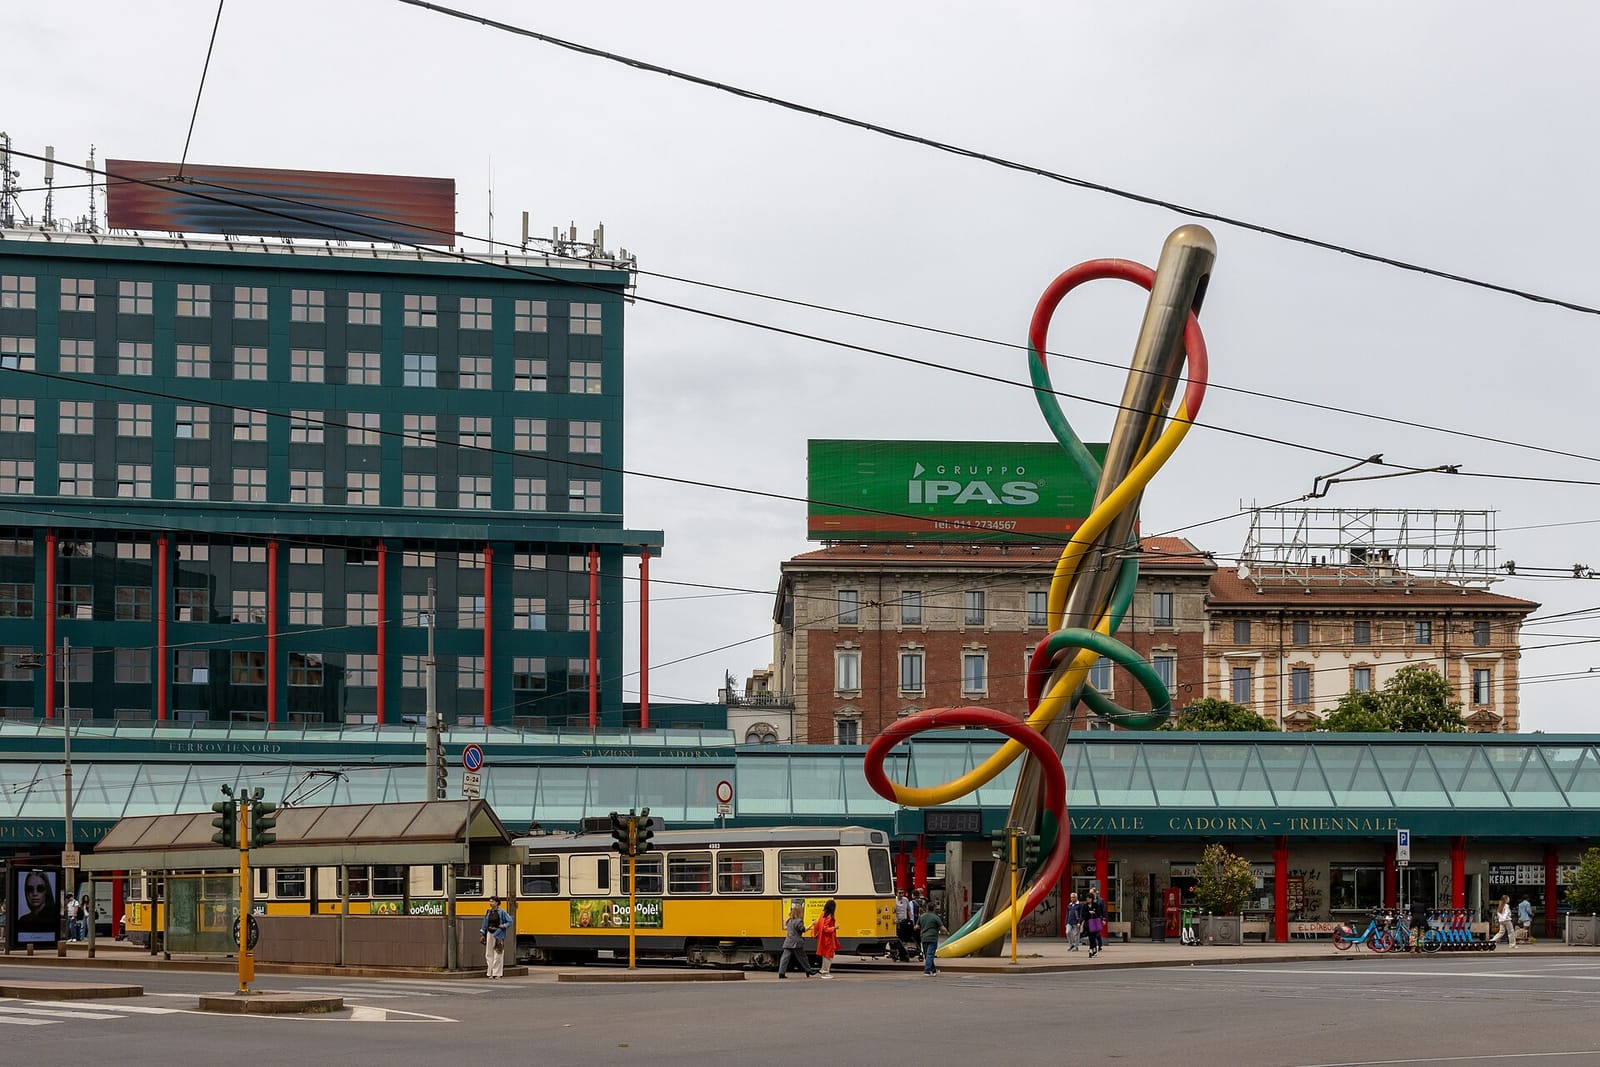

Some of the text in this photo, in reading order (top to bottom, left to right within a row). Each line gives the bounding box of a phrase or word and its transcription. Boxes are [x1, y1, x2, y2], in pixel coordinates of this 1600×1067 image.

[937, 465, 1025, 475] GRUPPO
[909, 479, 1039, 505] IPAS
[974, 520, 1017, 530] 2734567
[168, 742, 281, 753] FERROVIENORD
[1069, 817, 1144, 830] AZZALE
[1169, 817, 1267, 830] CADORNA
[1287, 817, 1398, 830] TRIENNALE
[1489, 875, 1515, 884] KEBAP
